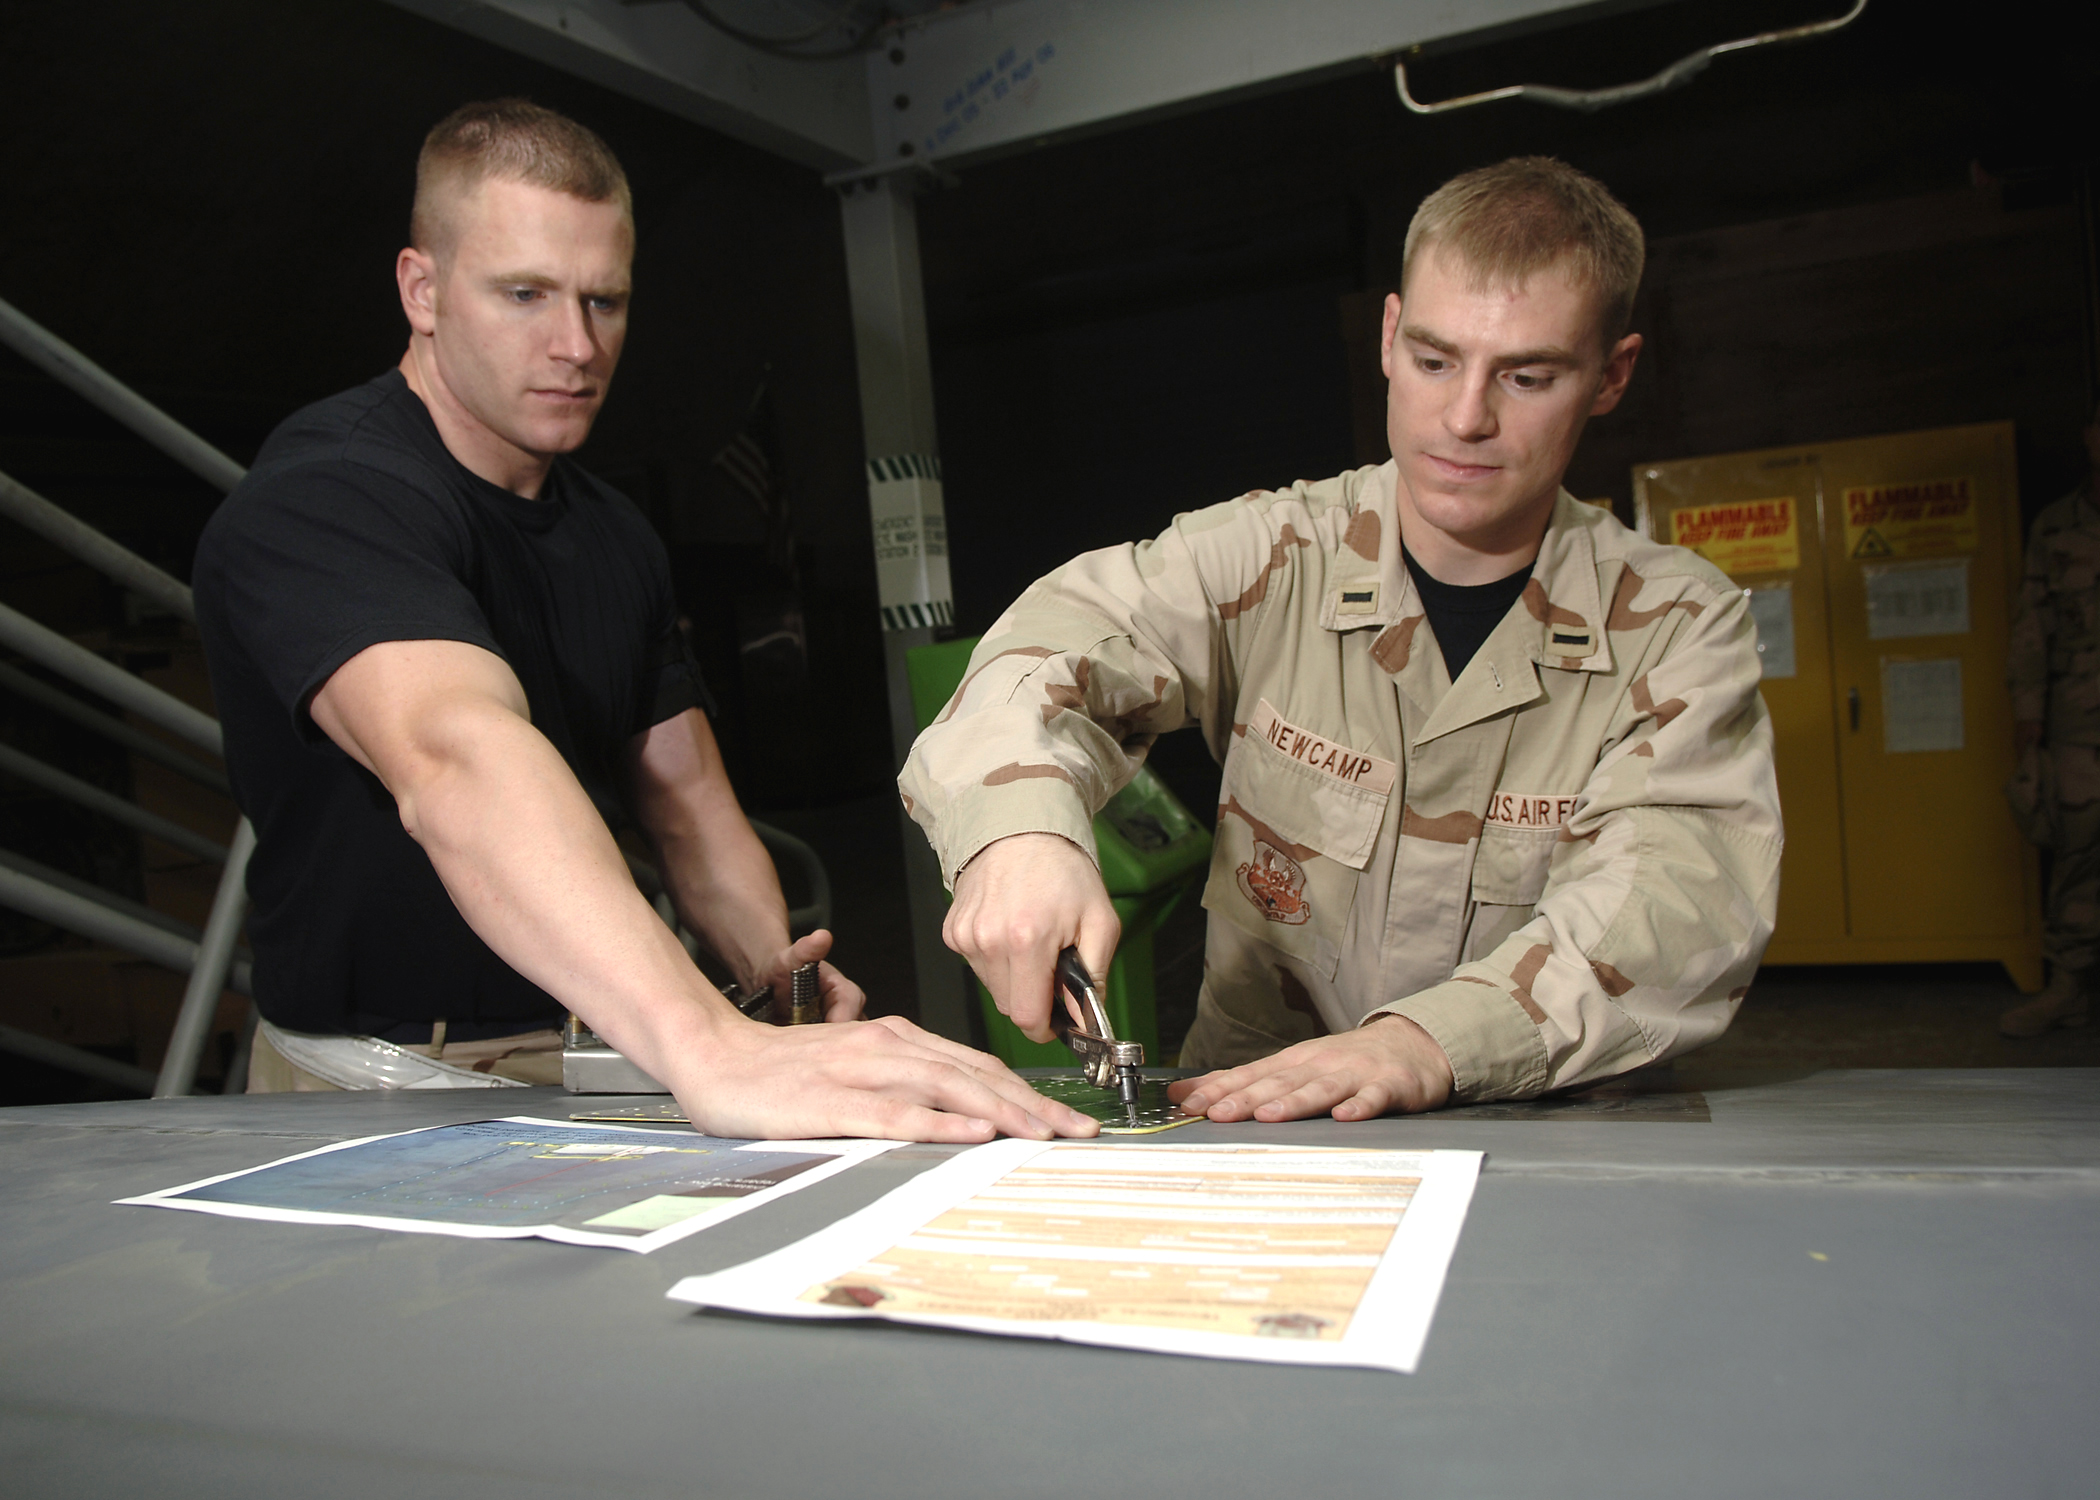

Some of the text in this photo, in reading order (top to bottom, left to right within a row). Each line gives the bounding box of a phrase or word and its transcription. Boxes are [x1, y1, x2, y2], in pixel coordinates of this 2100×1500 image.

[1849, 478, 1969, 511] FLAMMABLE
[1676, 500, 1789, 531] FLAMMABLE
[1679, 529, 1712, 546] KEEP
[1266, 718, 1373, 783] NEWCAMP
[1517, 798, 1551, 826] AIR
